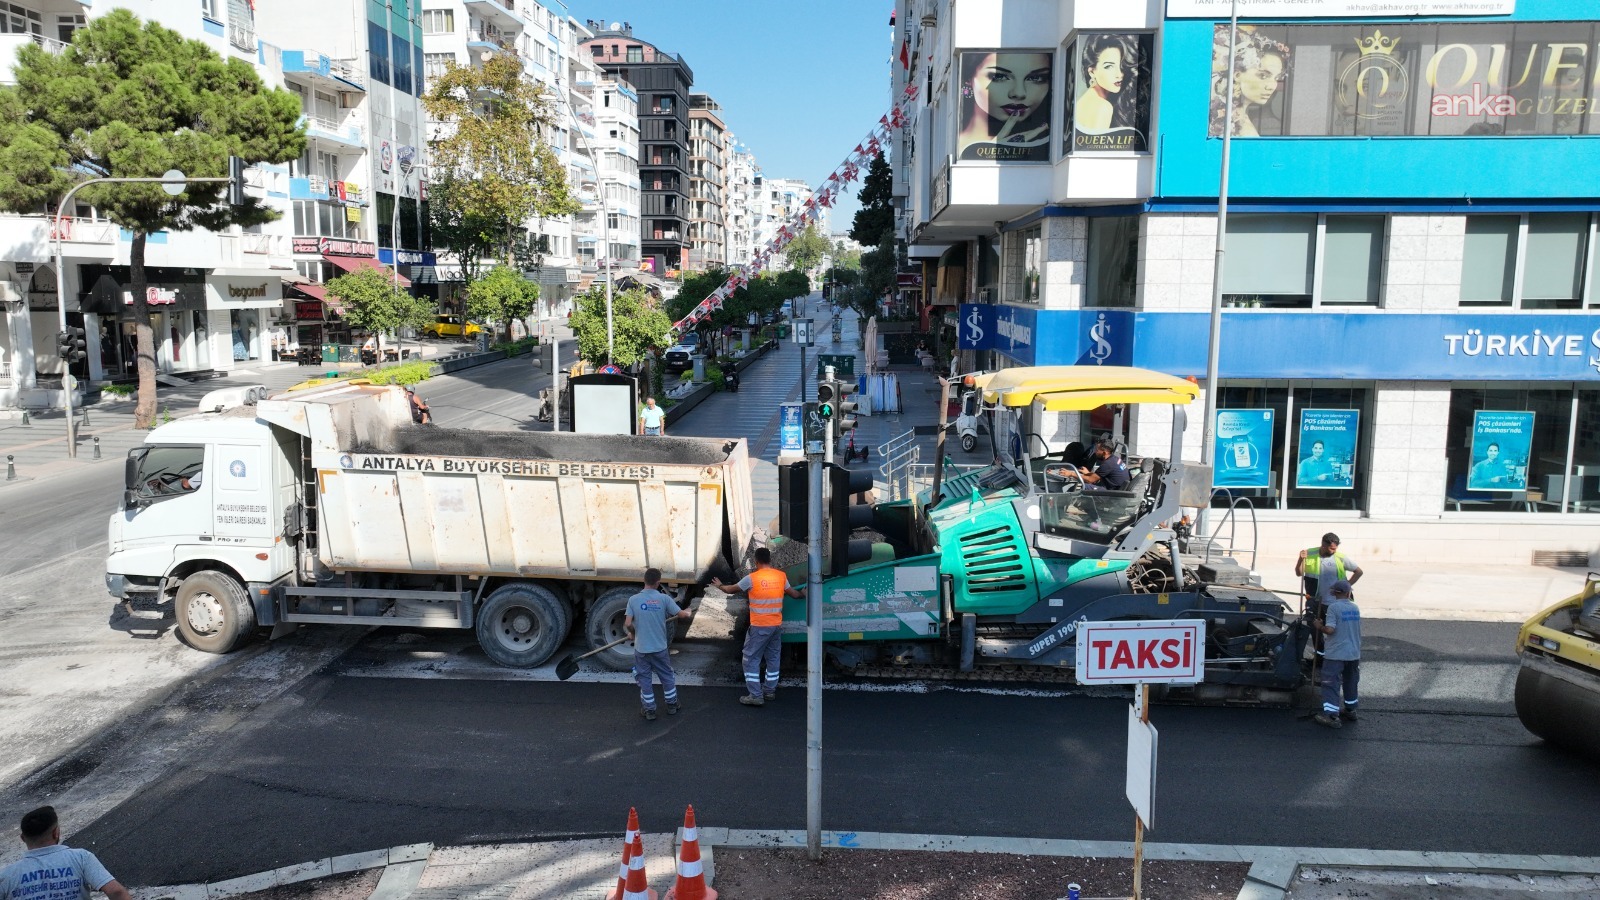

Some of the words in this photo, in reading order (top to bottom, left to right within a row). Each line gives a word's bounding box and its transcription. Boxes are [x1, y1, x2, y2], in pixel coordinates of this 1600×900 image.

[1346, 3, 1428, 12] akhav@akhav.org.tr
[1432, 3, 1503, 11] www.akhav.org.tr
[1077, 136, 1114, 146] QUEEN
[1118, 136, 1141, 145] LIFE
[977, 147, 1011, 157] QUEEN
[1443, 329, 1584, 356] TÜRKİYE
[363, 457, 435, 471] ANTALYA
[443, 459, 550, 475] BÜYÜKŞEHİR
[559, 463, 655, 478] BELEDİYESİ
[1029, 633, 1056, 656] SUPER
[1092, 631, 1191, 670] TAKSİ
[21, 867, 73, 884] ANTALYA
